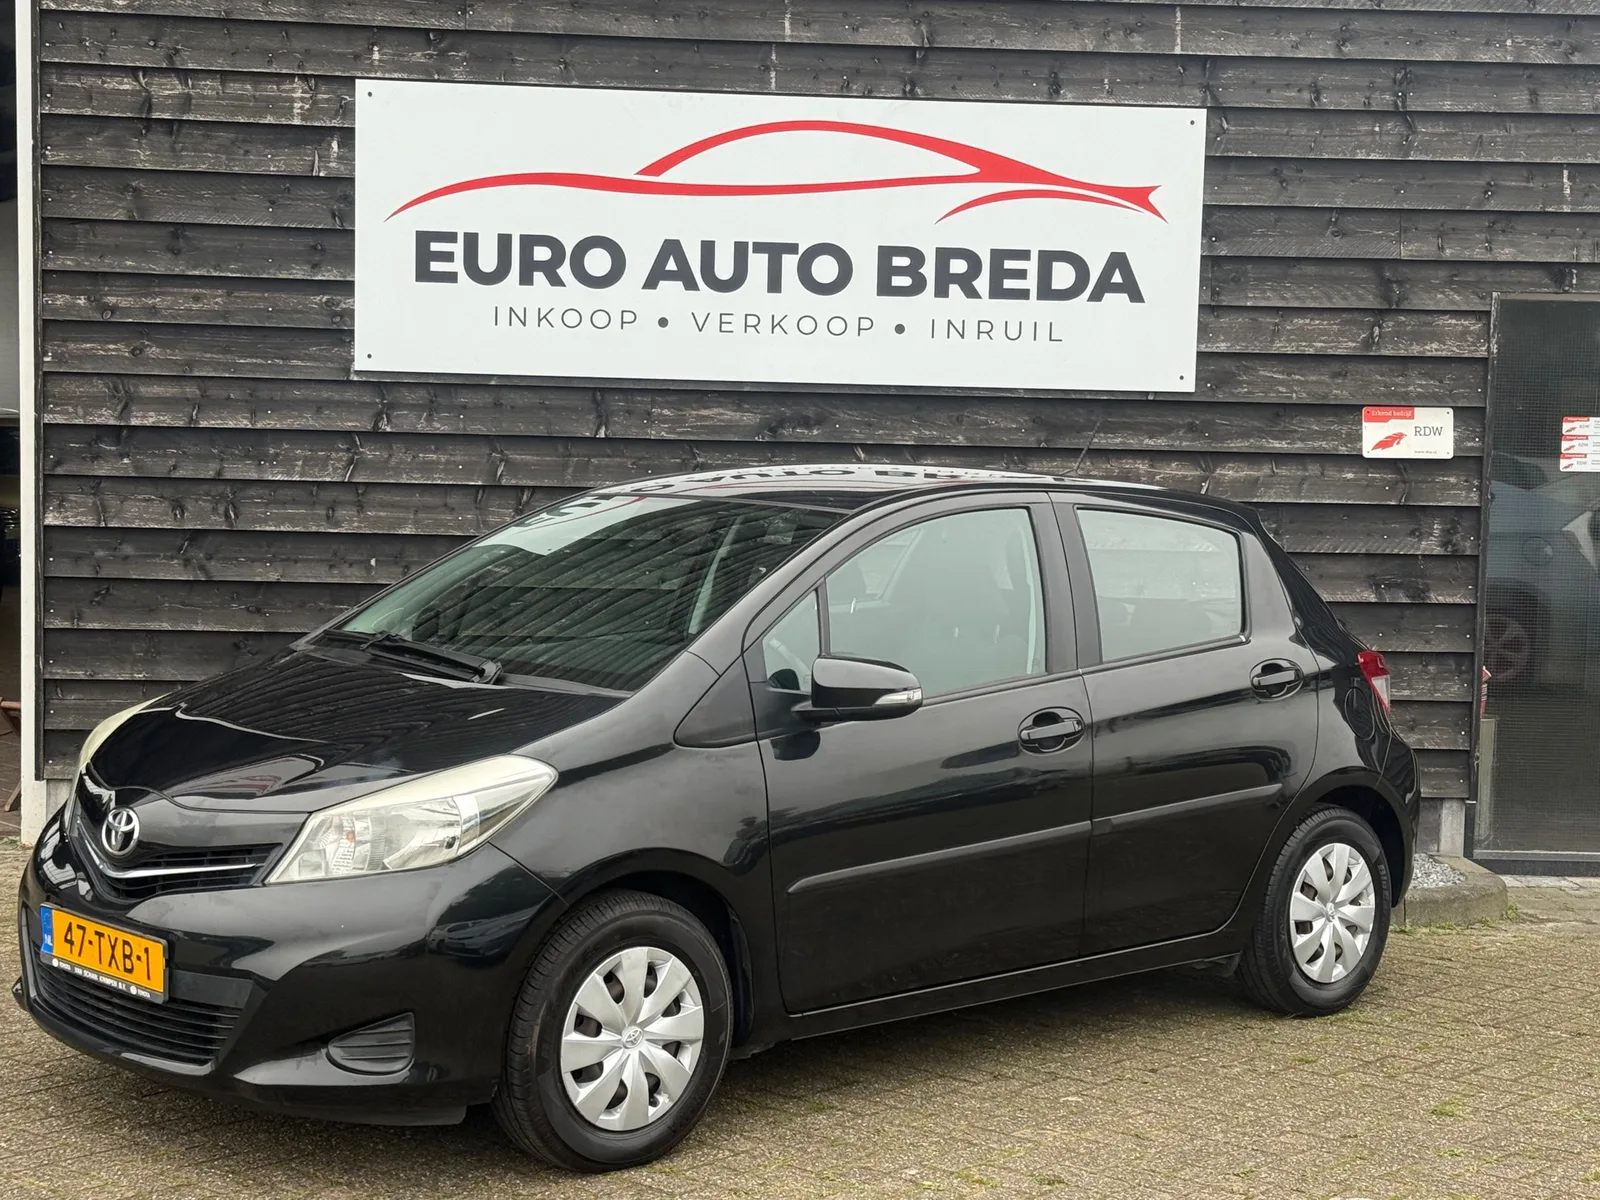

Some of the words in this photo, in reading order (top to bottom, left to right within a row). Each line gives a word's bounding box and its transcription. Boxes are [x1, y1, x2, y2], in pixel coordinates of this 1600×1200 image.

[414, 230, 627, 290] EURO
[641, 238, 854, 297] AUTO
[876, 245, 1146, 304] BREDA
[494, 305, 637, 330] INKOOP
[691, 311, 874, 337] VERKOOP
[931, 318, 1063, 342] INRUIL
[1393, 410, 1412, 418] bedrijf
[1414, 426, 1443, 437] RDW
[63, 921, 151, 981] 47-TXB-1
